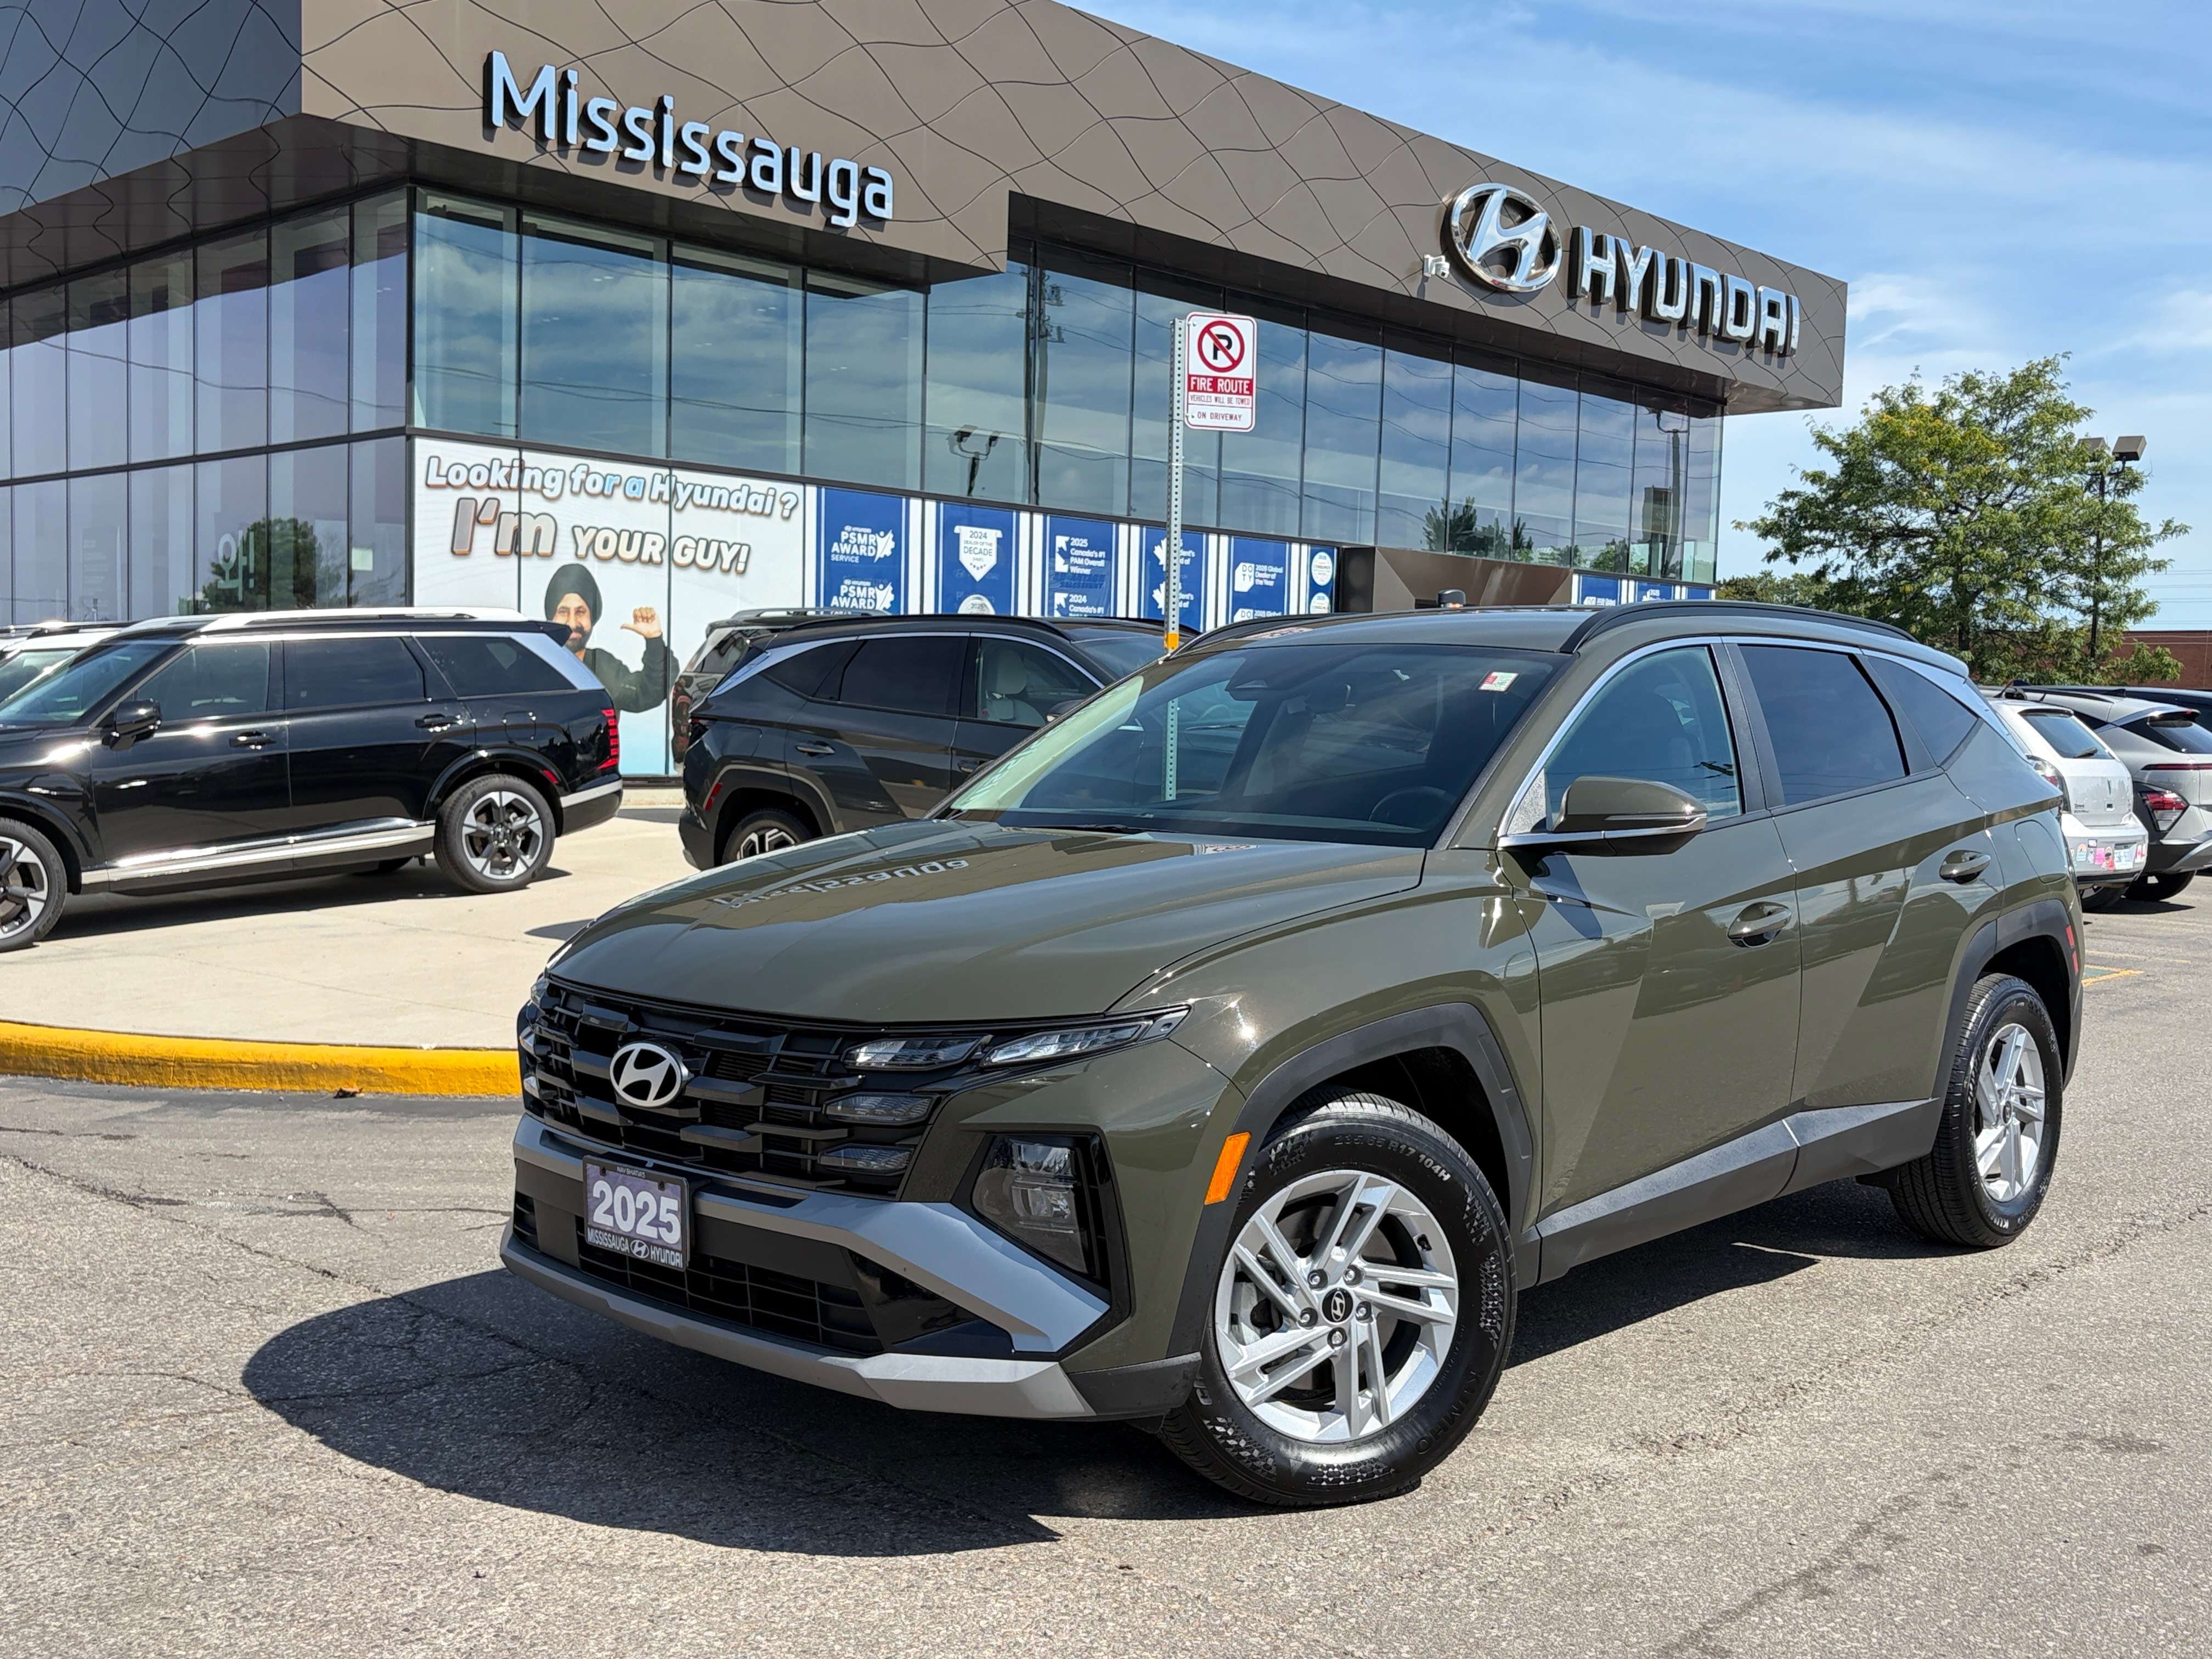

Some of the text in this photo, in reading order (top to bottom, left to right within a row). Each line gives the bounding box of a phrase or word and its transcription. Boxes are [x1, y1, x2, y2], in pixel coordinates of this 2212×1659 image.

[486, 49, 894, 228] Mississauga
[1572, 225, 1799, 358] HYUNDAI
[1190, 377, 1250, 394] FIRE ROUTE
[1190, 394, 1212, 403] VEHICLES
[1210, 412, 1243, 422] DRIVEWAY
[426, 456, 565, 499] Looking
[570, 464, 626, 496] for
[624, 476, 646, 499] a
[451, 497, 751, 574] I'm YOUR GUY!
[840, 531, 877, 546] PSMR
[969, 530, 988, 539] 2024
[831, 541, 876, 557] AWARD
[1070, 538, 1088, 547] 2025
[963, 546, 994, 556] DECADE
[1070, 548, 1098, 558] Canada's
[831, 554, 860, 563] SERVICE
[1084, 558, 1105, 567] Overall
[1070, 566, 1092, 575] Winner
[840, 585, 876, 599] PSMR
[1069, 594, 1087, 603] 2024
[830, 596, 876, 610] AWARD
[1069, 605, 1097, 614] Canada's
[1387, 1140, 1417, 1158] R17
[1418, 1154, 1452, 1181] 104H
[592, 1180, 682, 1245] 2025
[587, 1227, 684, 1269] MISSISSAUGA HYUNDAI
